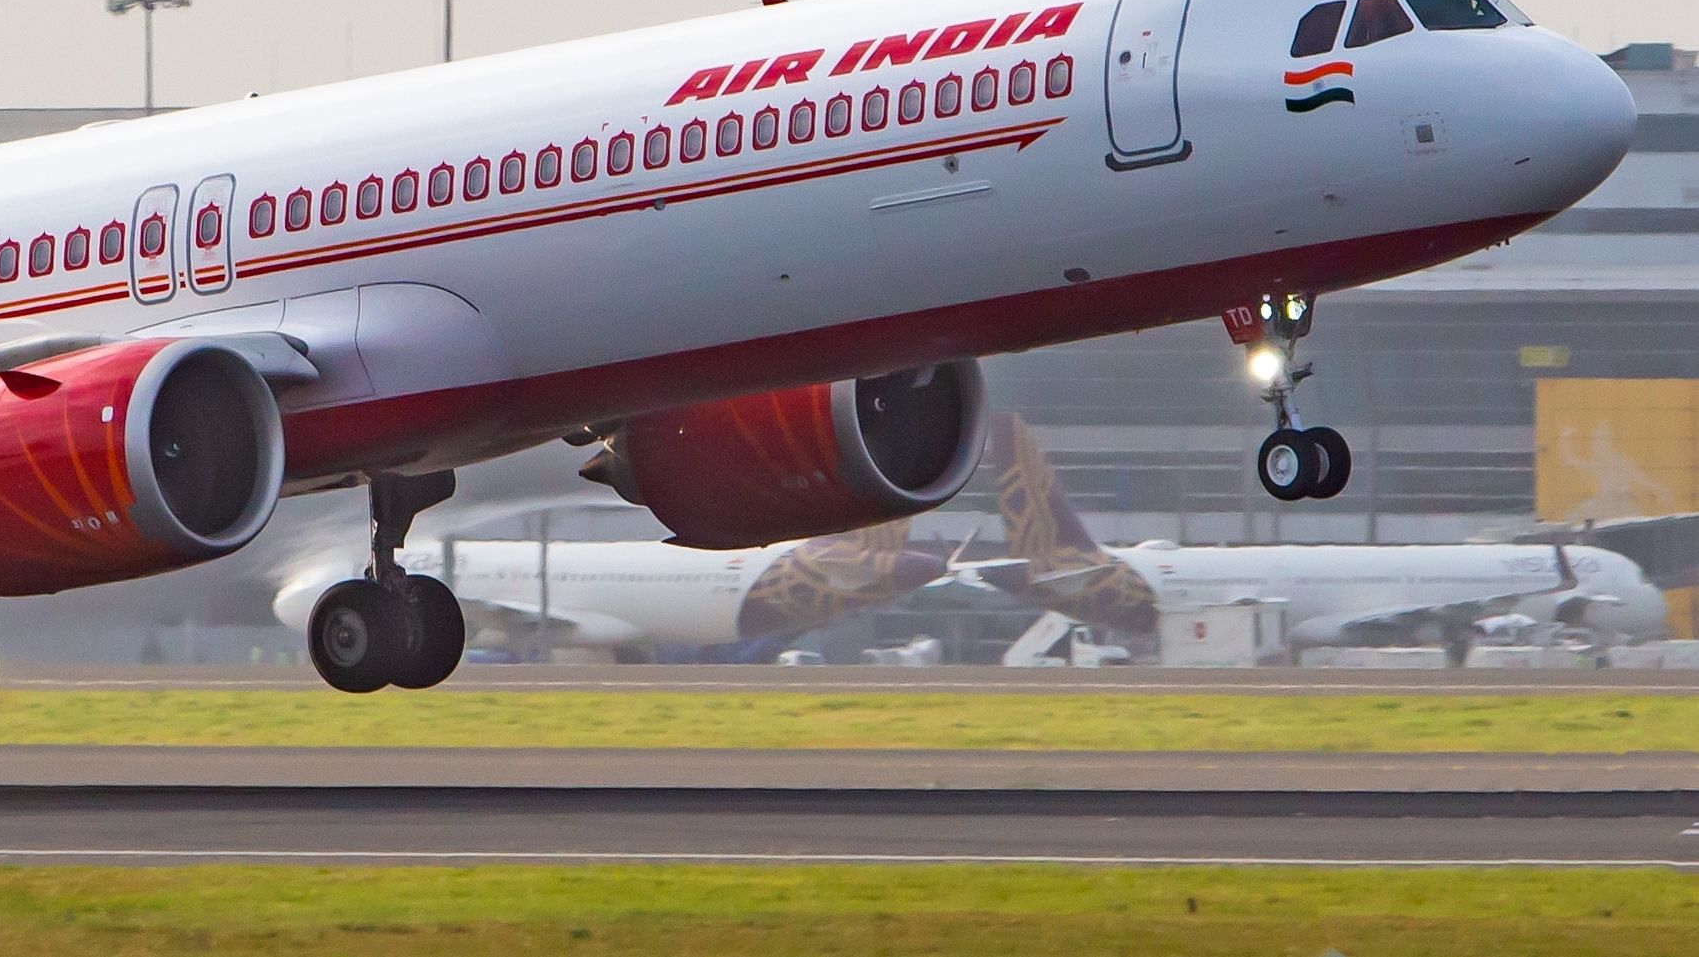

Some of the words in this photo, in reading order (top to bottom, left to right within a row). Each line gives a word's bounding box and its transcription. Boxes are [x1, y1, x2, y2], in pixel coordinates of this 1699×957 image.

[665, 49, 825, 106] AIR
[829, 2, 1083, 76] INDIA
[1226, 306, 1253, 328] TD
